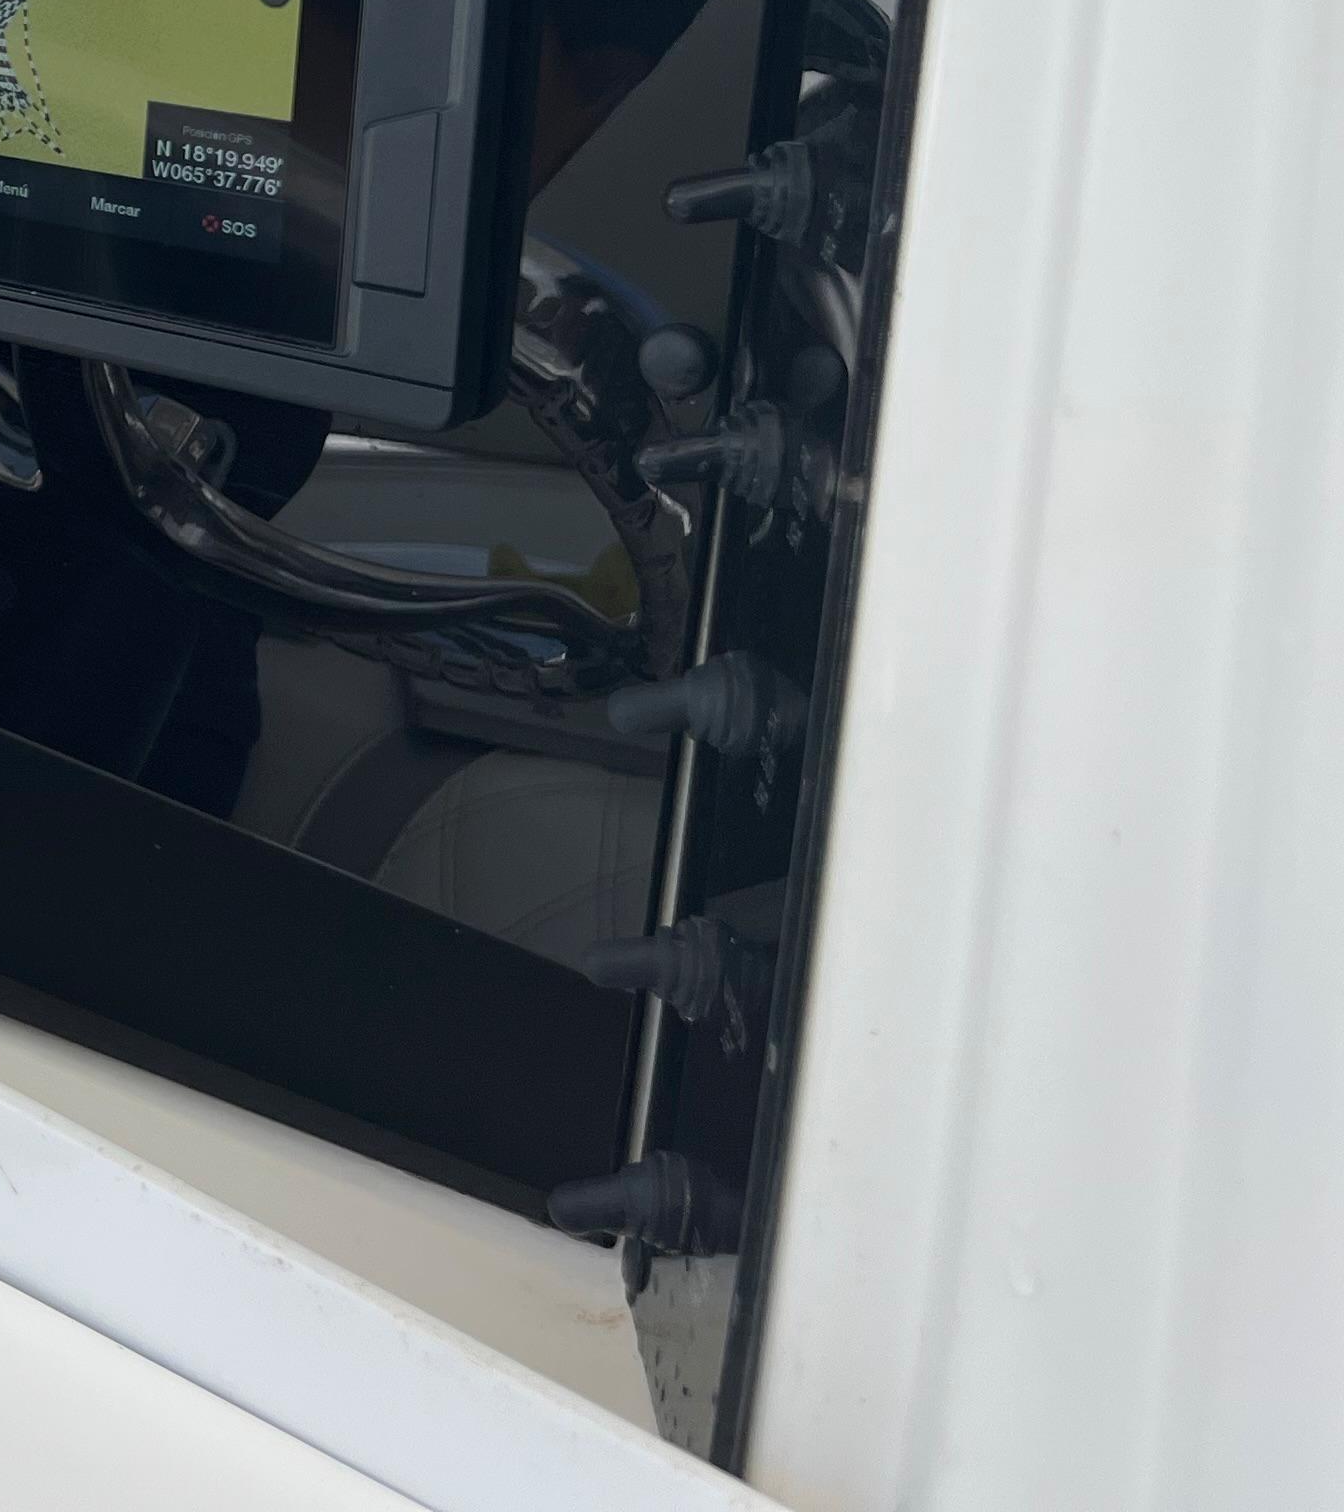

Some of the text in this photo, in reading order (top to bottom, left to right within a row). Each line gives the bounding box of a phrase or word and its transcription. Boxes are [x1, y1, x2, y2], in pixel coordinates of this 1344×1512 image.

[156, 139, 172, 157] N
[228, 133, 253, 146] GPS
[91, 196, 141, 217] Marcar
[221, 219, 256, 238] SOS
